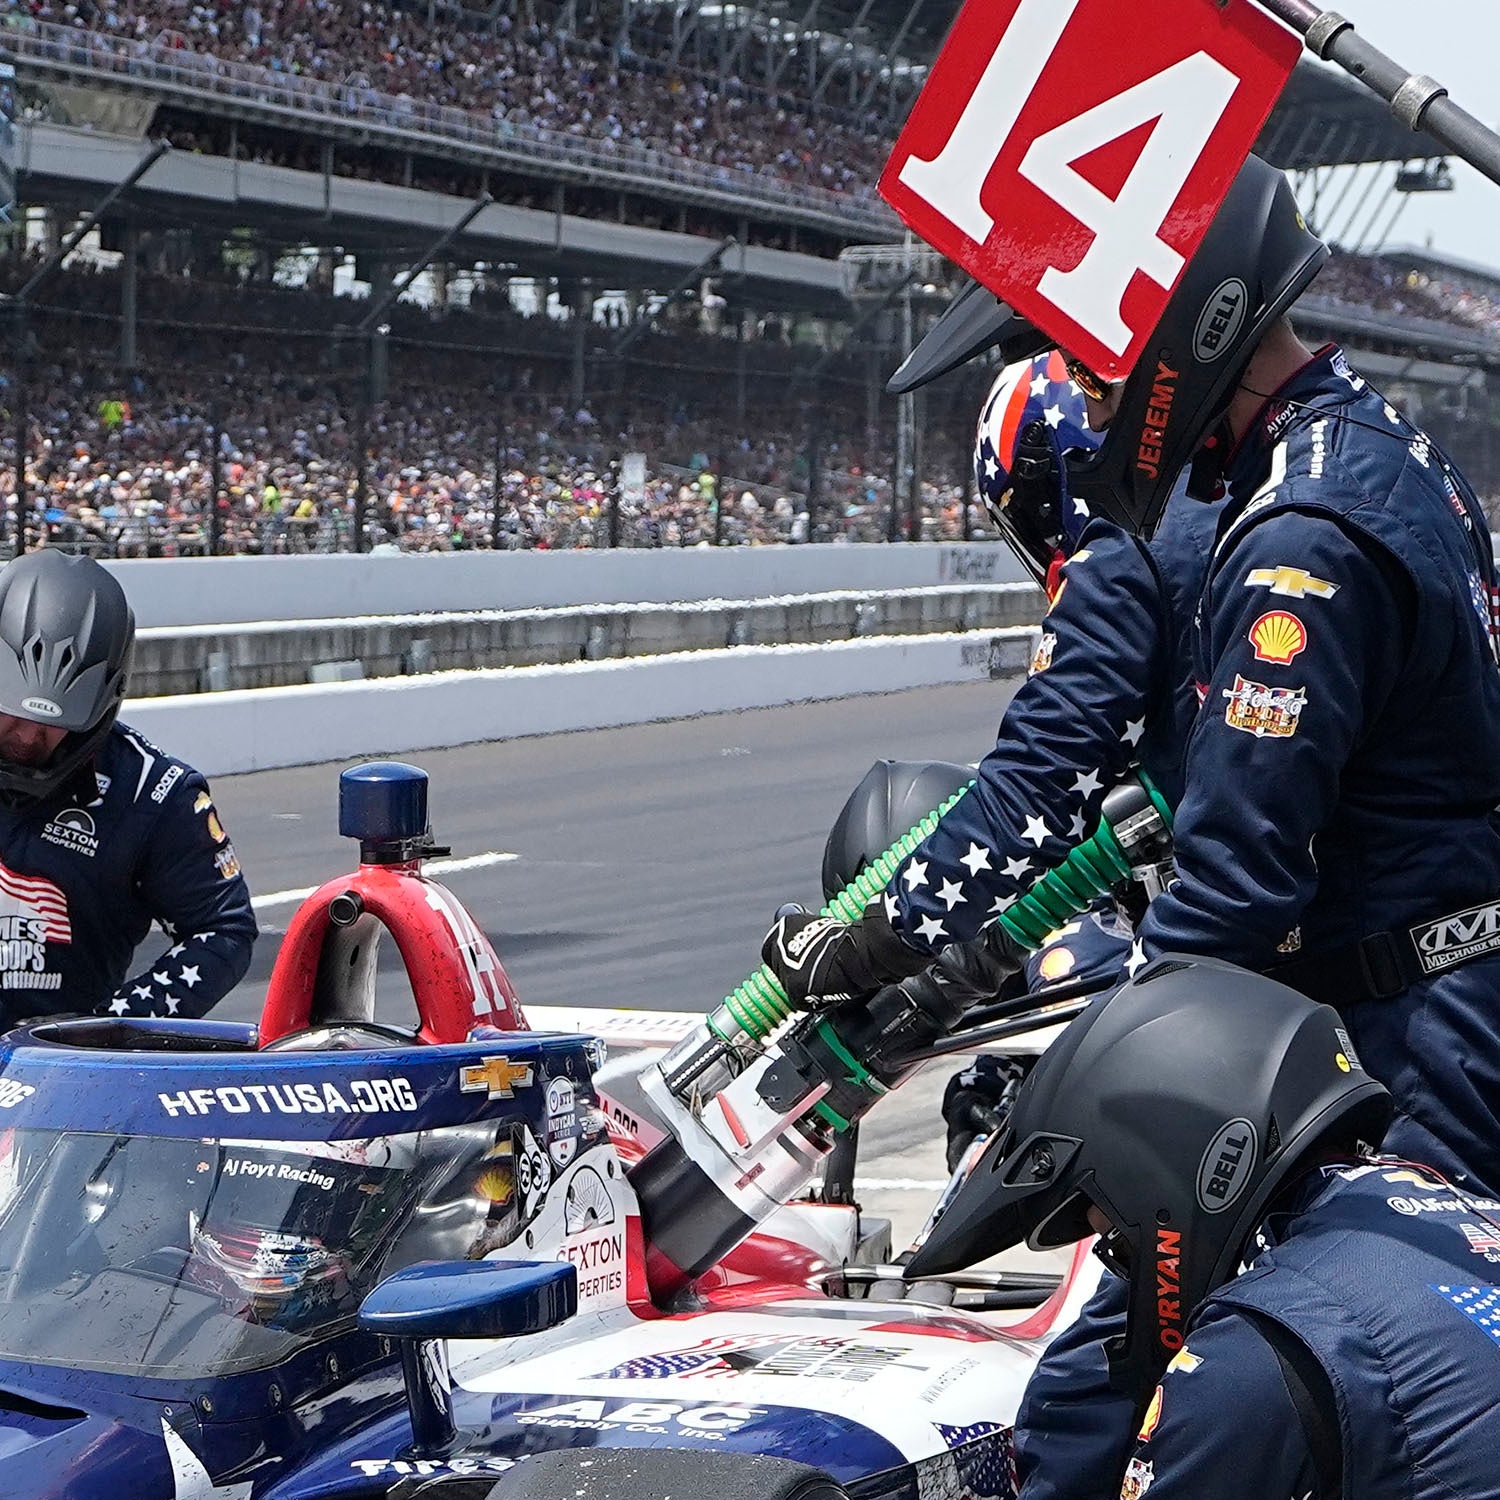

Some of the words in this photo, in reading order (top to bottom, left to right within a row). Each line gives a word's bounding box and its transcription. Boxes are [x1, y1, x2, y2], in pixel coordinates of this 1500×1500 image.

[900, 0, 1242, 357] 14
[1202, 287, 1240, 352] BELL
[1137, 358, 1180, 480] JEREMY
[28, 700, 56, 714] BELL
[150, 764, 184, 805] sparco
[40, 832, 97, 858] PROPERTIES
[43, 822, 100, 849] SEXTON
[1424, 940, 1488, 970] MECHANIX
[158, 1078, 418, 1117] HFOTUSA.ORG
[223, 1159, 239, 1177] AJ
[239, 1161, 275, 1179] Foyt
[277, 1165, 336, 1190] Racing
[1205, 1134, 1249, 1200] BELL
[579, 1271, 623, 1300] PERTIES
[1156, 1229, 1184, 1351] O'RYAN
[513, 1399, 768, 1431] ABC
[515, 1415, 620, 1432] Supply
[624, 1421, 669, 1435] Co.
[677, 1427, 727, 1442] Inc.
